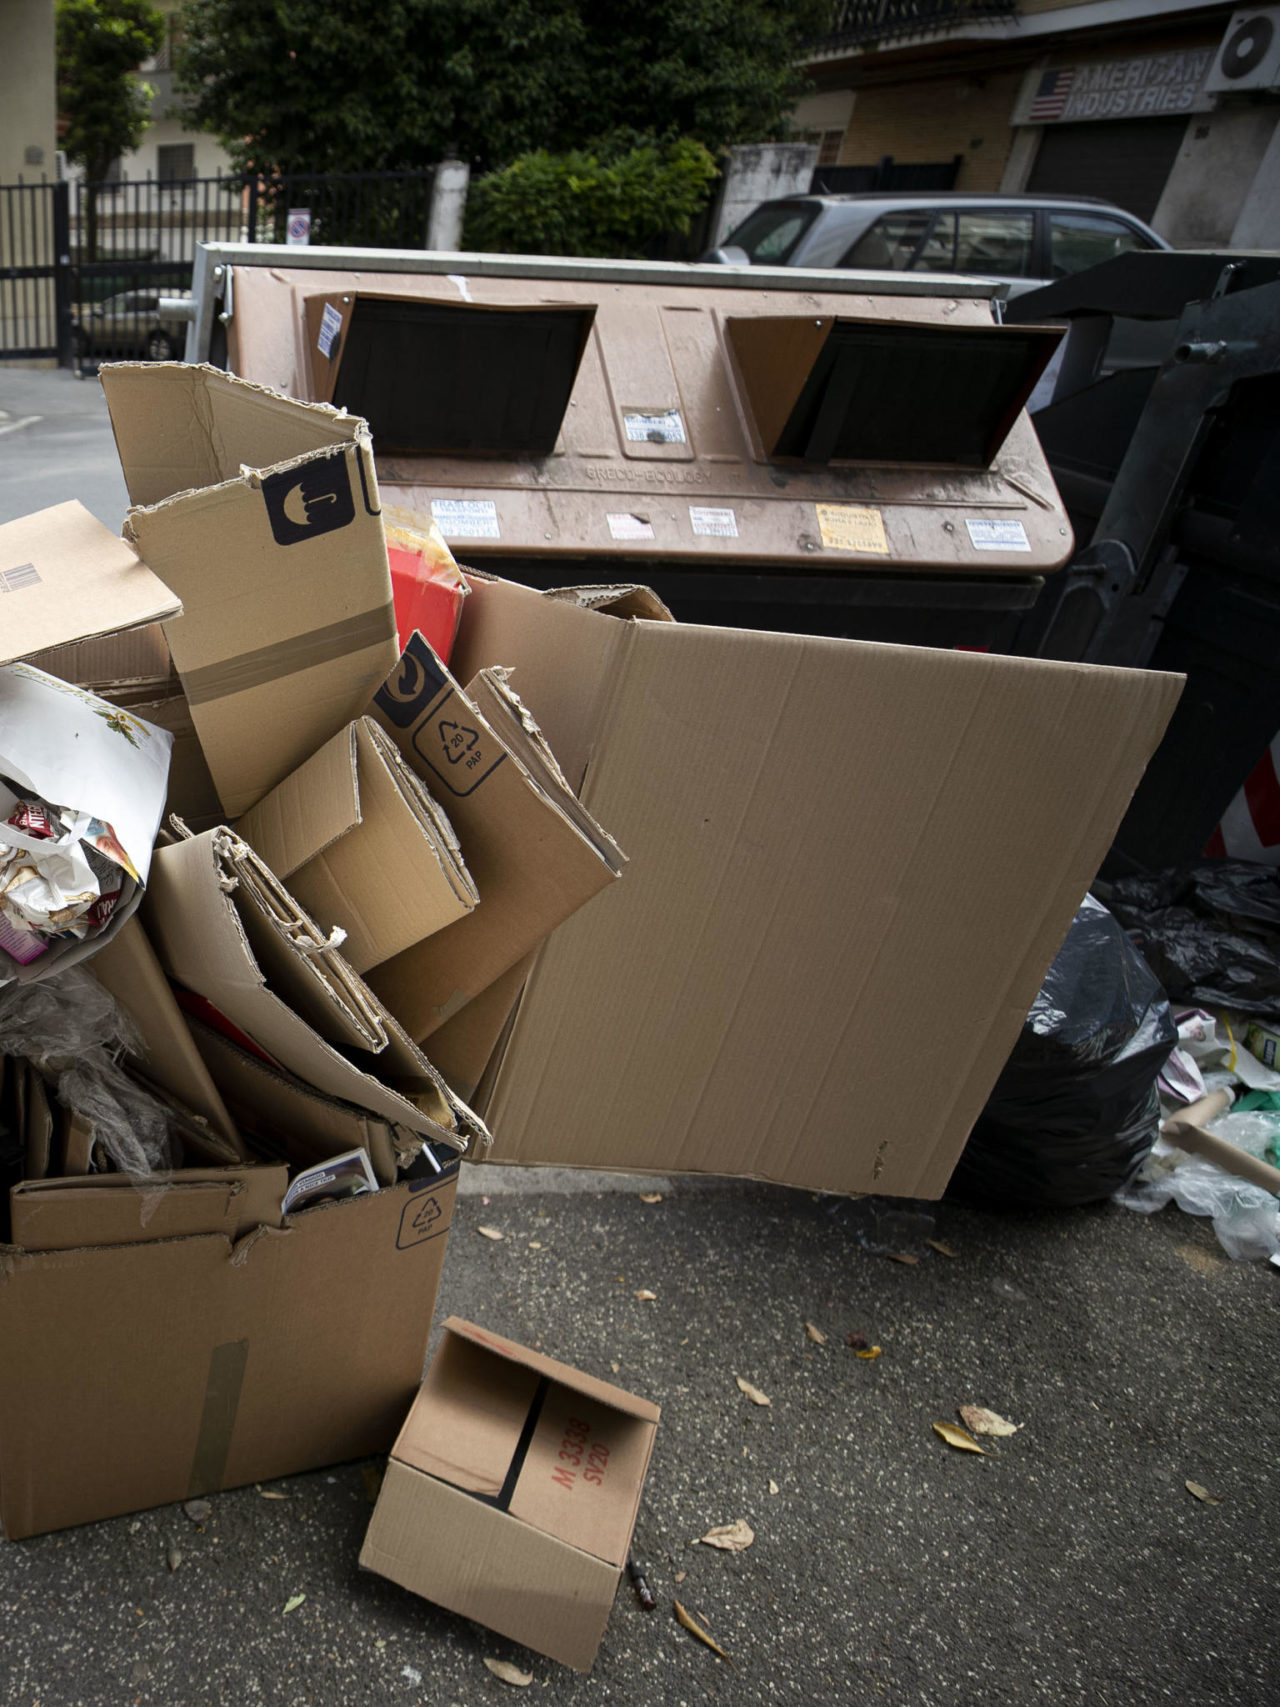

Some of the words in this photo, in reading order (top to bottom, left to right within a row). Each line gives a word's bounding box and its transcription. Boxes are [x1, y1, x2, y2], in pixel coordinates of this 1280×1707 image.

[1072, 51, 1212, 92] AMERICAN
[1062, 83, 1196, 117] INDUSTRIES
[450, 733, 464, 748] 20
[465, 751, 482, 770] PAP
[551, 1466, 577, 1491] M
[583, 1443, 610, 1487] SV20
